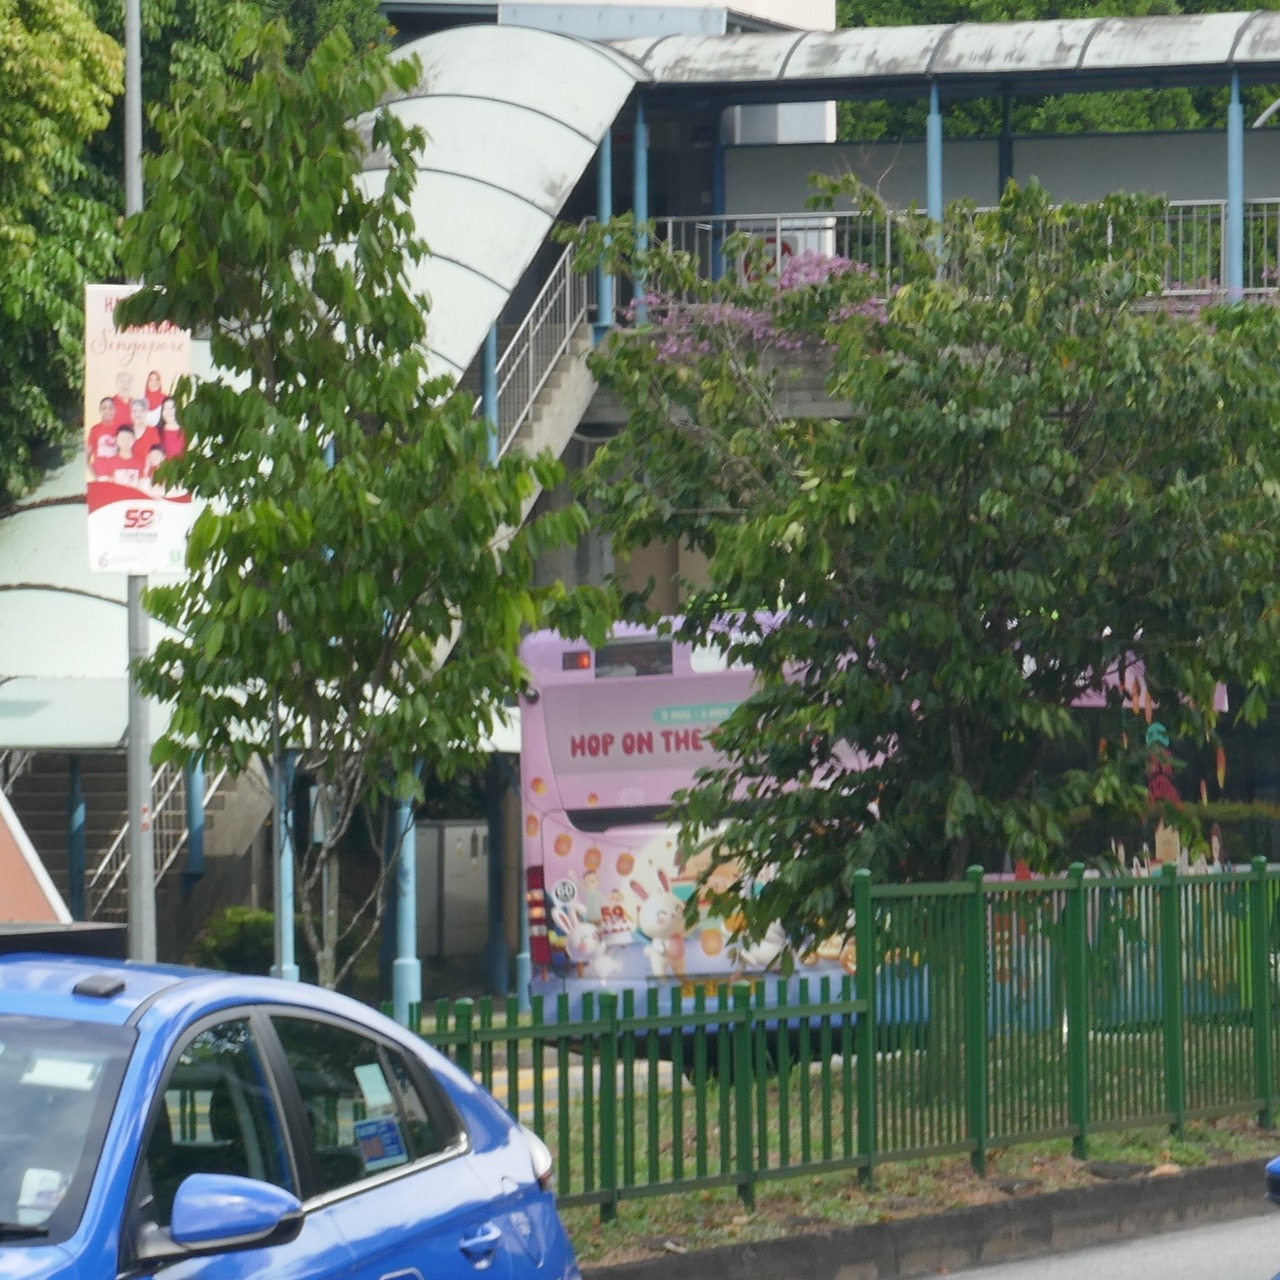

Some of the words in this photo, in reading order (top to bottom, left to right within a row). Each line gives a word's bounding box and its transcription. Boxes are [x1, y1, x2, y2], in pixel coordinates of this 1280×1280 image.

[90, 328, 184, 366] Singapore
[570, 731, 616, 759] HOP
[622, 729, 653, 755] ON
[661, 727, 704, 753] THE
